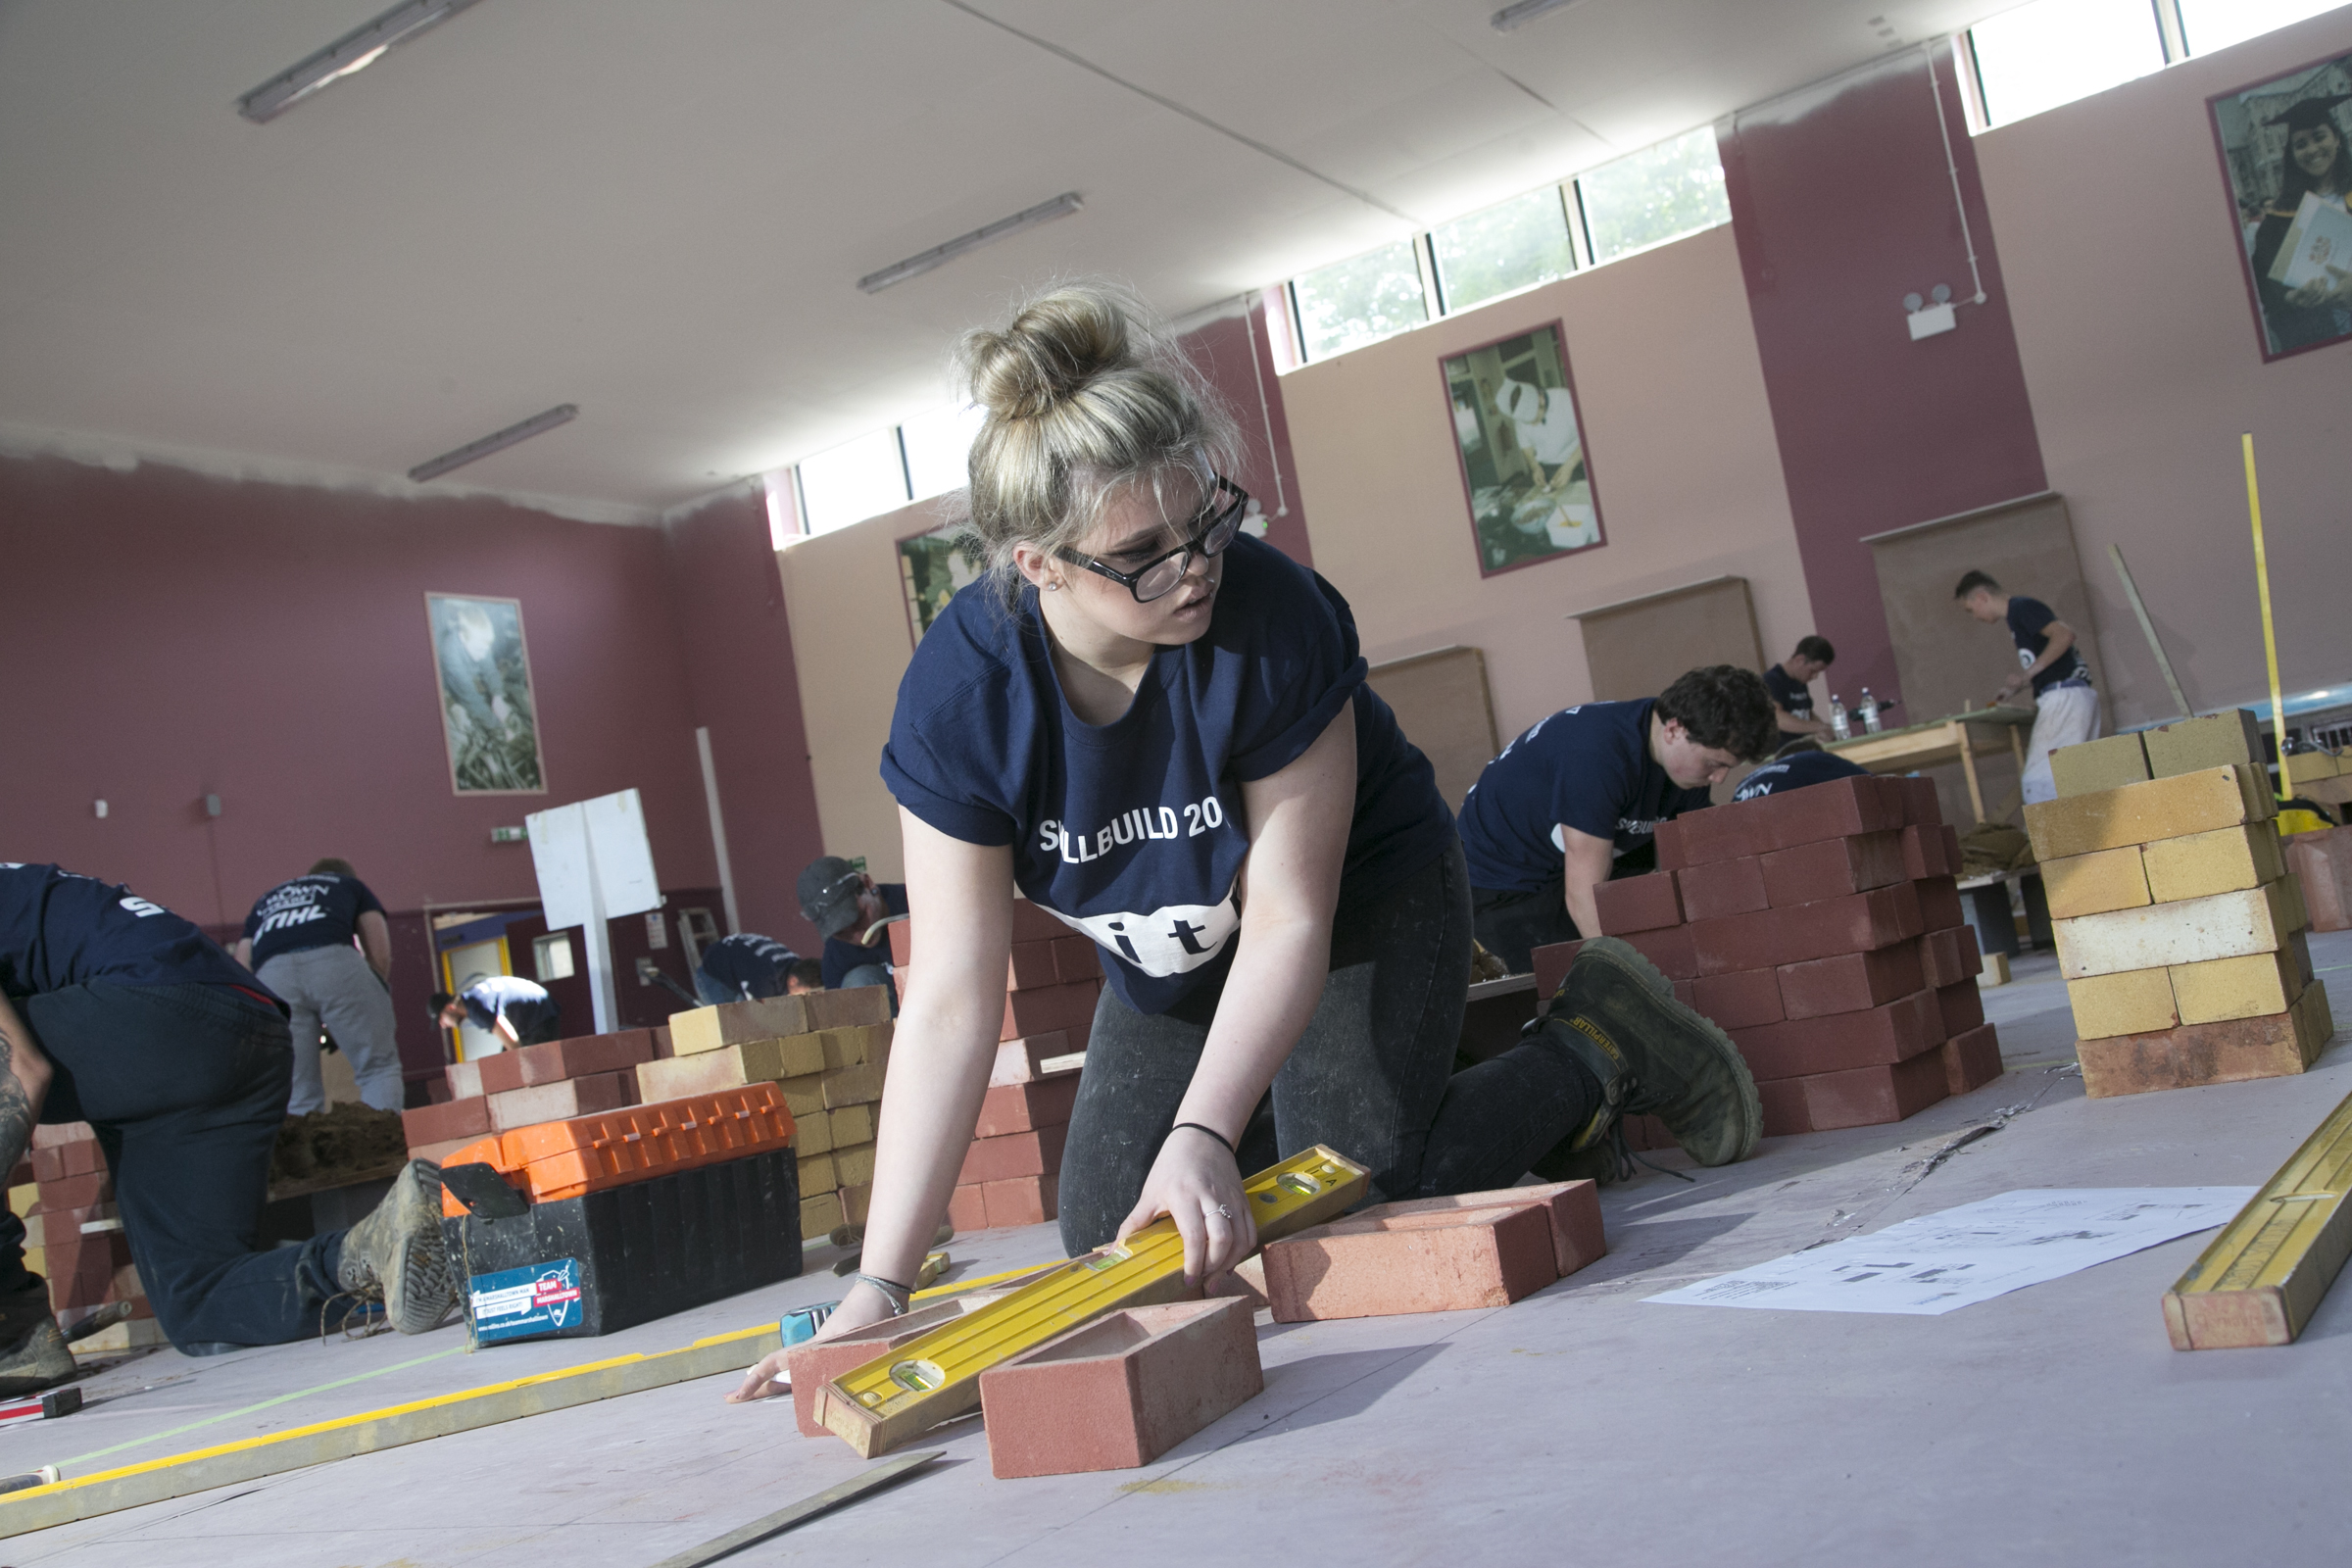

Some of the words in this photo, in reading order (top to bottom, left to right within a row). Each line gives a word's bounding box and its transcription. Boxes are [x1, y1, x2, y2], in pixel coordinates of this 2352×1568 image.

[1039, 807, 1179, 864] SILLBUILD
[1573, 1016, 1619, 1060] CATERPILLAR
[539, 1281, 557, 1292] TEAM
[486, 1290, 519, 1301] MARSHALLTOWN
[536, 1290, 577, 1303] MARSHALLTOWN
[497, 1303, 509, 1312] FEELS
